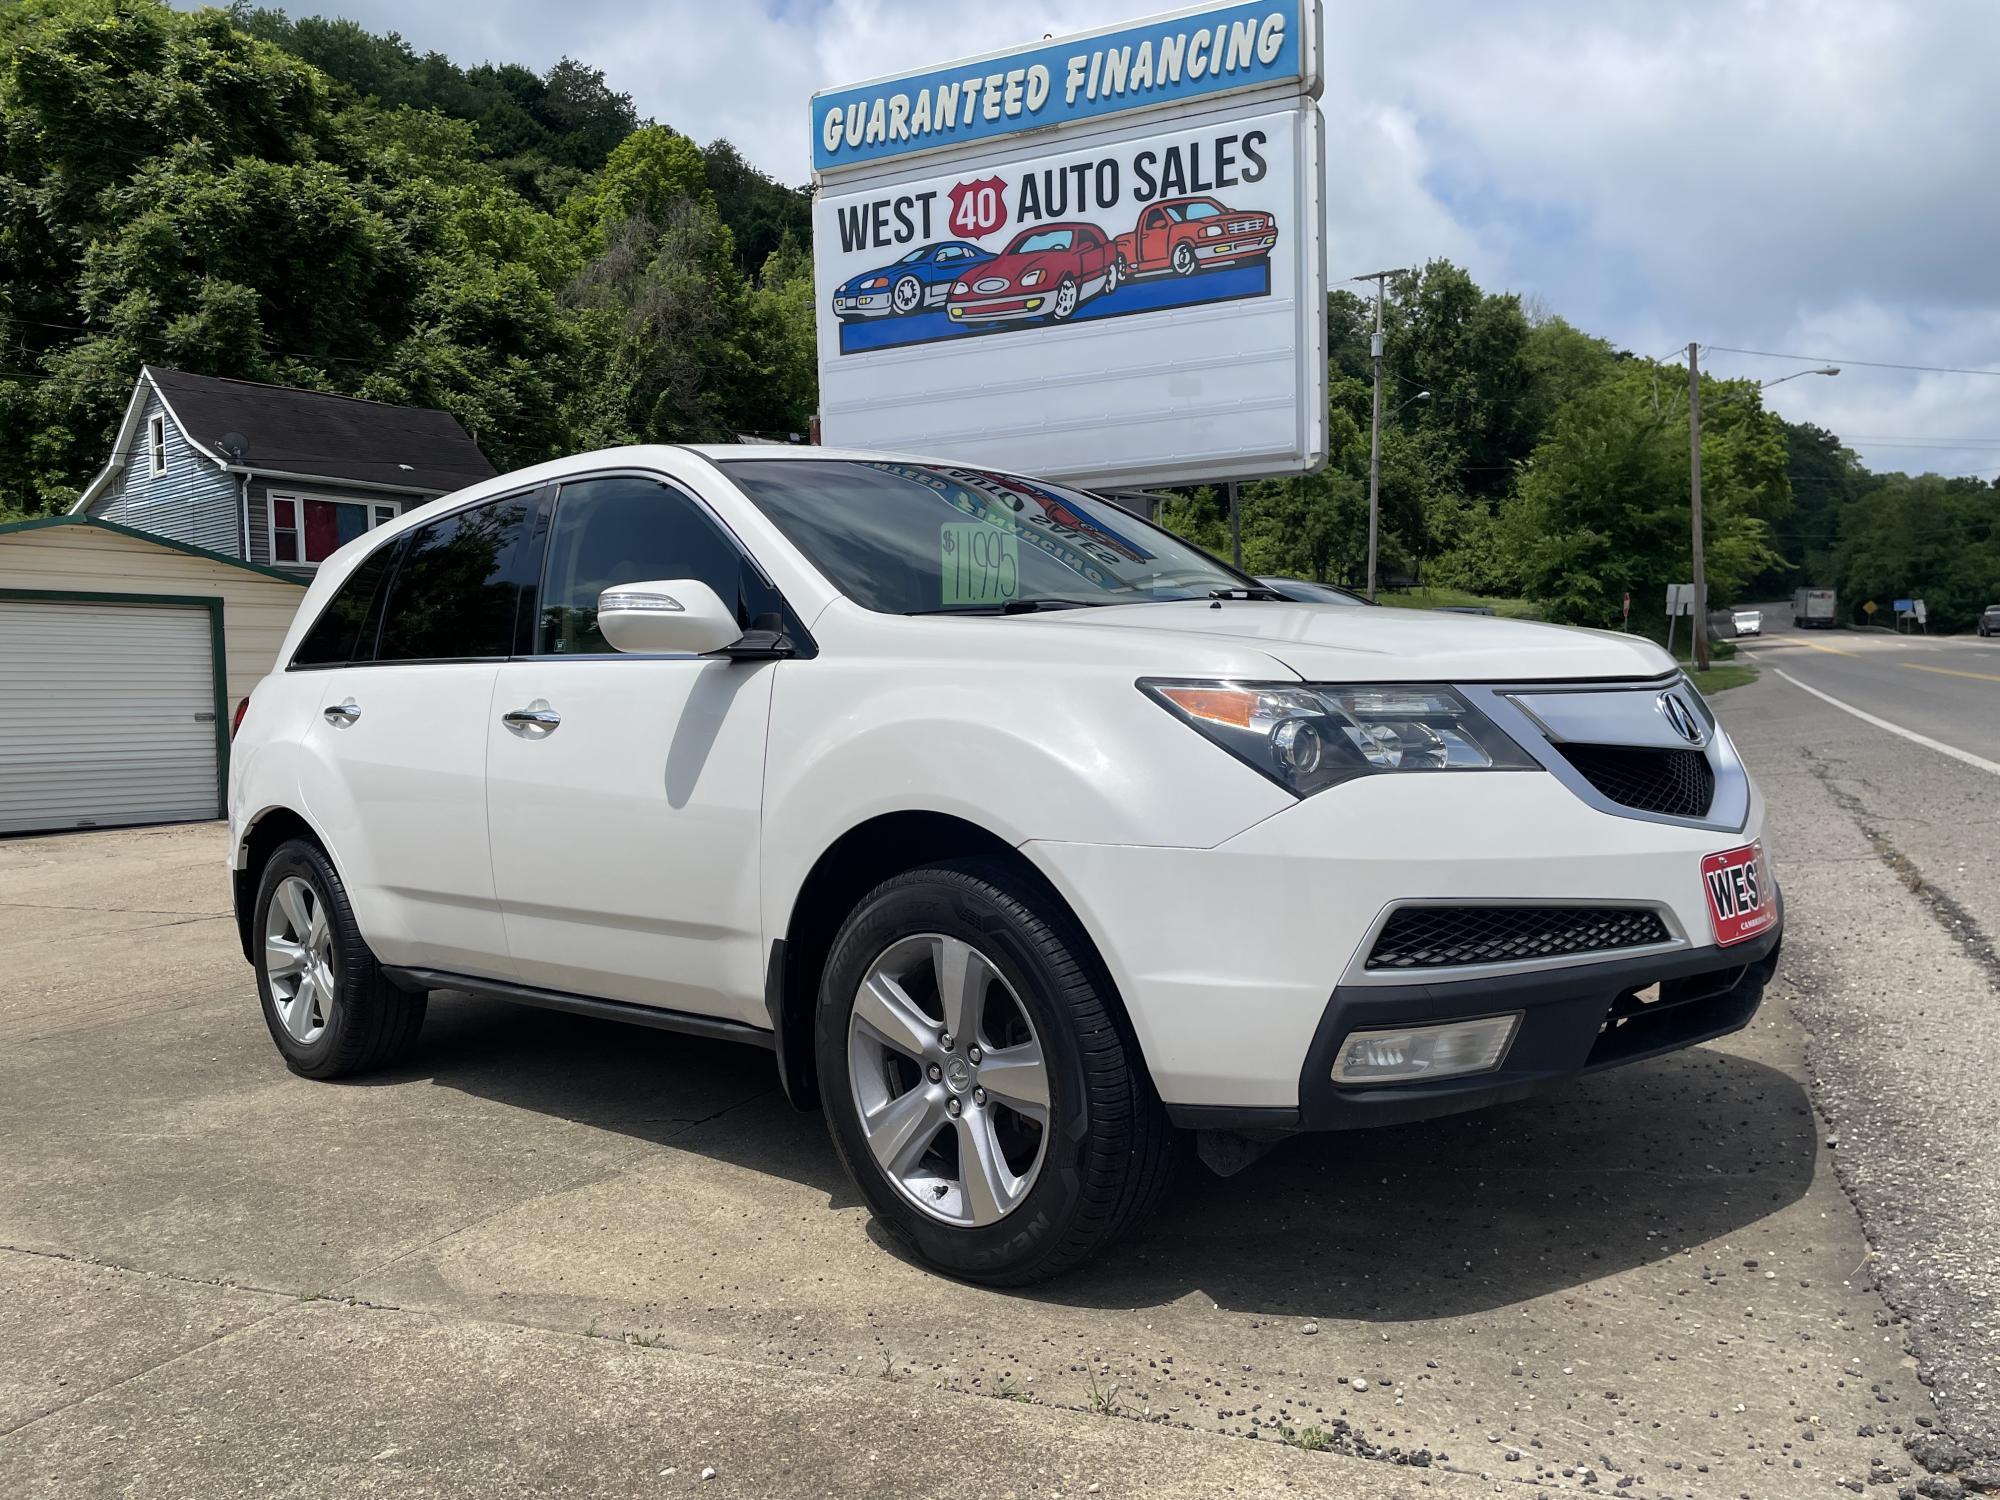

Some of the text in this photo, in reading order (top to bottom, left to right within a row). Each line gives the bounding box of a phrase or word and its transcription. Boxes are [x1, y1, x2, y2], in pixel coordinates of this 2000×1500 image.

[823, 12, 1285, 152] GUARANTEED FINANCING
[838, 130, 1267, 253] WEST 40 AUTO SALES
